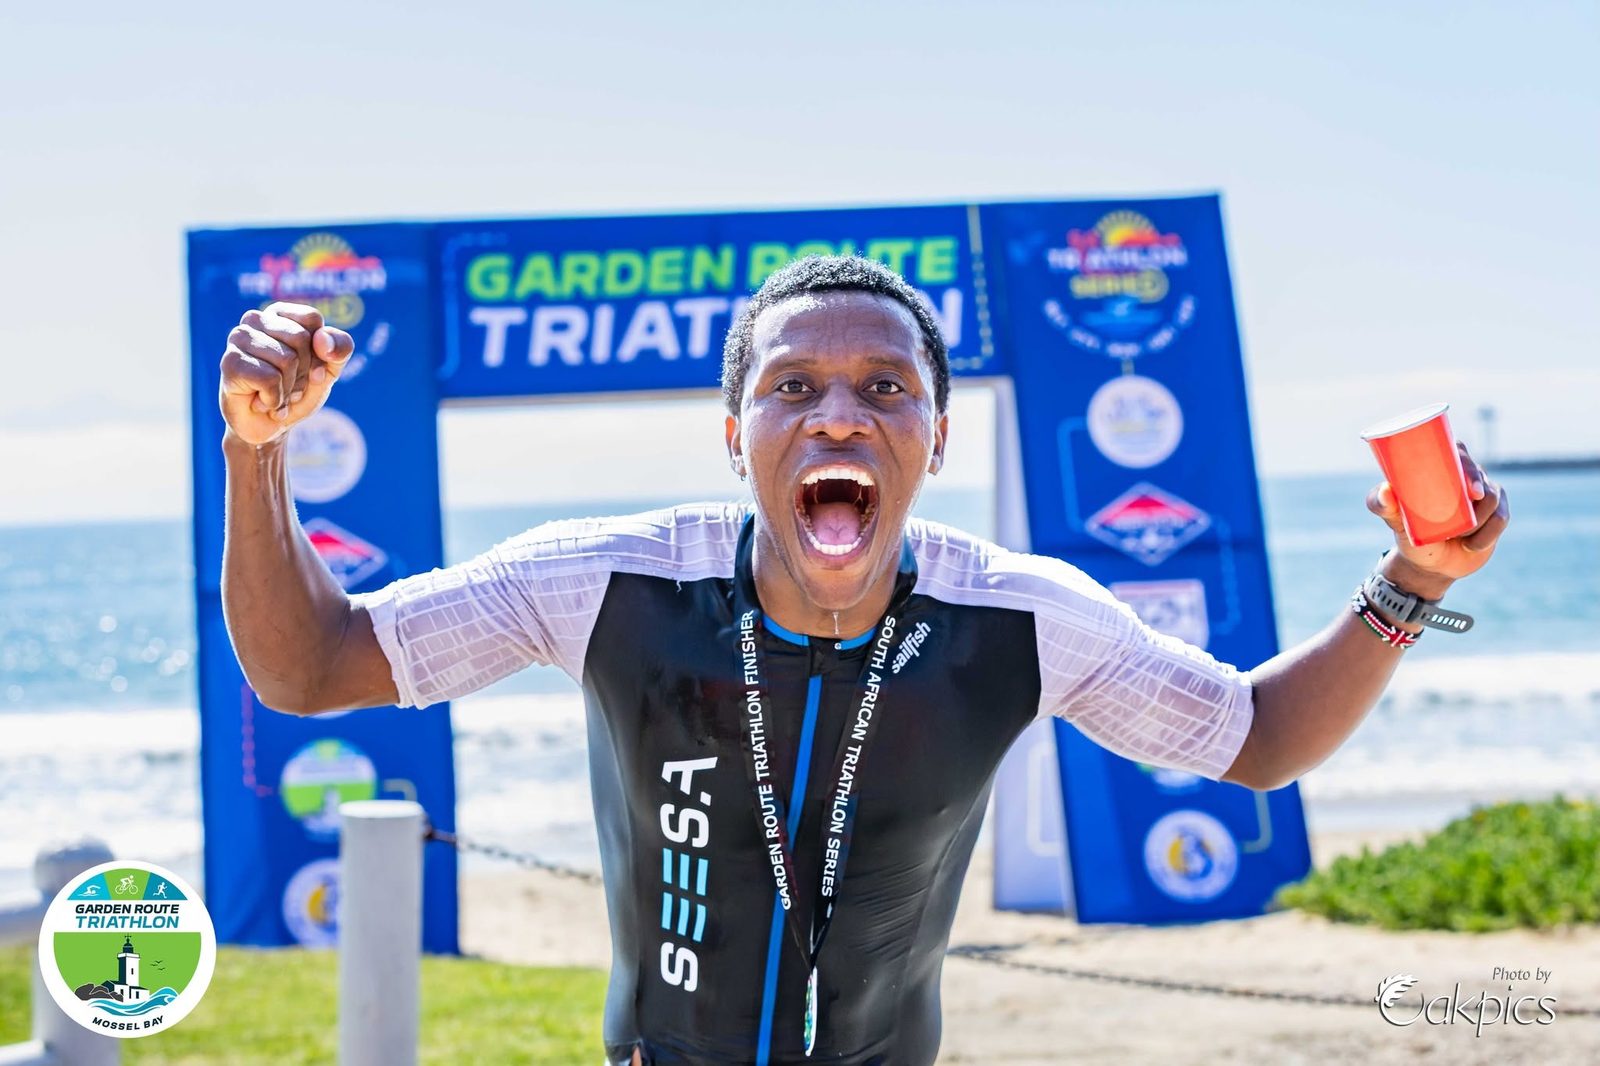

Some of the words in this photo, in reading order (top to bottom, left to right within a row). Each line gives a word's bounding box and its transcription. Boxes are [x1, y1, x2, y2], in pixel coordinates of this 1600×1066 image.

[467, 241, 736, 300] GARDEN
[750, 236, 957, 288] RTE
[469, 287, 963, 368] TRIATN
[740, 609, 759, 686] FINISHER
[870, 615, 897, 669] SOUTH
[891, 621, 932, 674] sailfish
[746, 690, 770, 781] TRIATHLON
[851, 671, 882, 741] AFRICAN
[758, 784, 780, 839] ROUTE
[829, 745, 862, 833] TRIATHLON
[768, 843, 792, 910] GARDEN
[822, 837, 841, 897] SERIES
